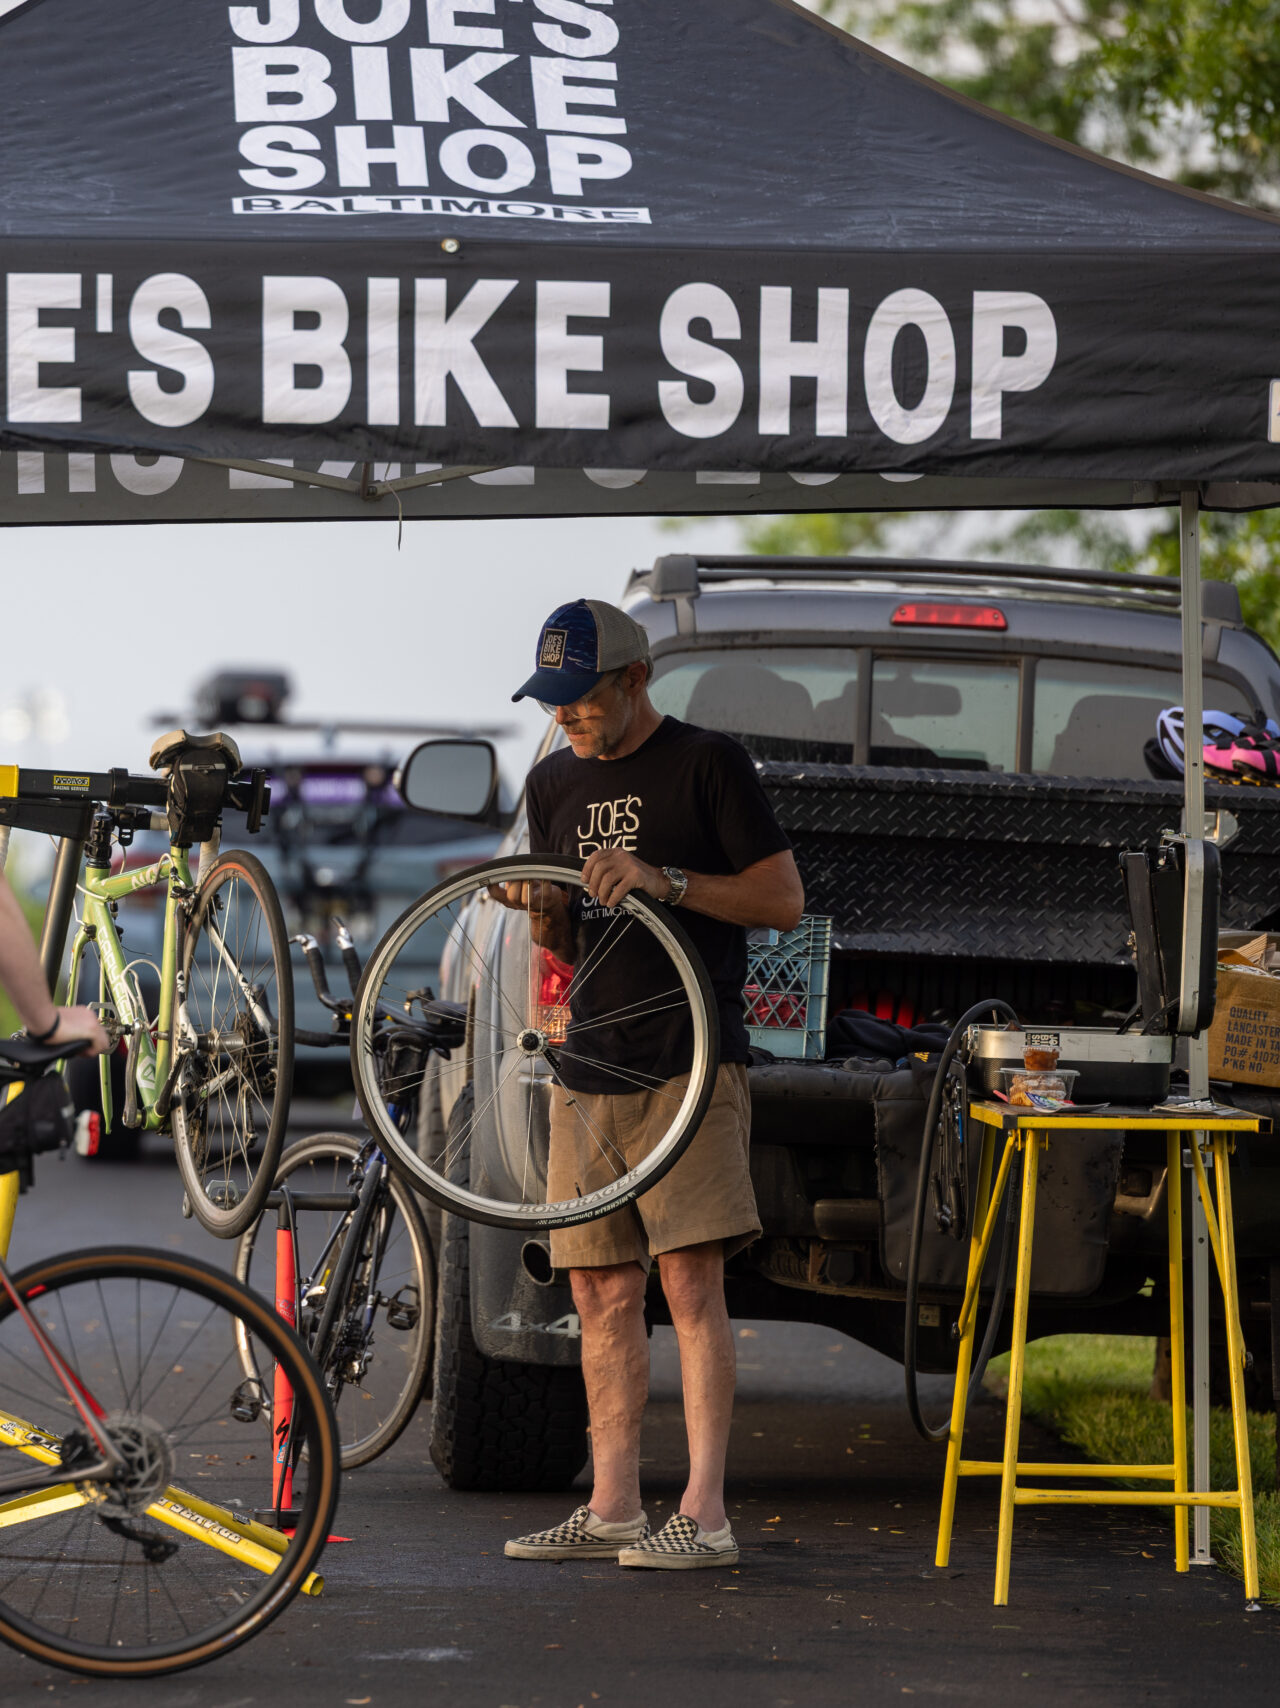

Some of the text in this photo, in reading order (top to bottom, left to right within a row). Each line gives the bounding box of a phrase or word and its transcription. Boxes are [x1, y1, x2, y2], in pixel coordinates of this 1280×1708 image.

[228, 0, 620, 58] JOES
[231, 46, 627, 135] BIKE
[238, 125, 633, 196] SHOP
[240, 197, 643, 222] BALTIMORE
[261, 275, 610, 430] BIKE
[657, 281, 1058, 445] SHOP
[543, 644, 562, 654] BIKE
[546, 634, 563, 645] JOE'S
[542, 653, 560, 663] SHOP
[577, 794, 642, 839] JOE'S
[1229, 1006, 1269, 1022] QUALITY
[1225, 1032, 1253, 1048] MADE
[1256, 1038, 1268, 1049] IN
[518, 1168, 641, 1214] BONTRAGER
[488, 1312, 583, 1339] 4x4
